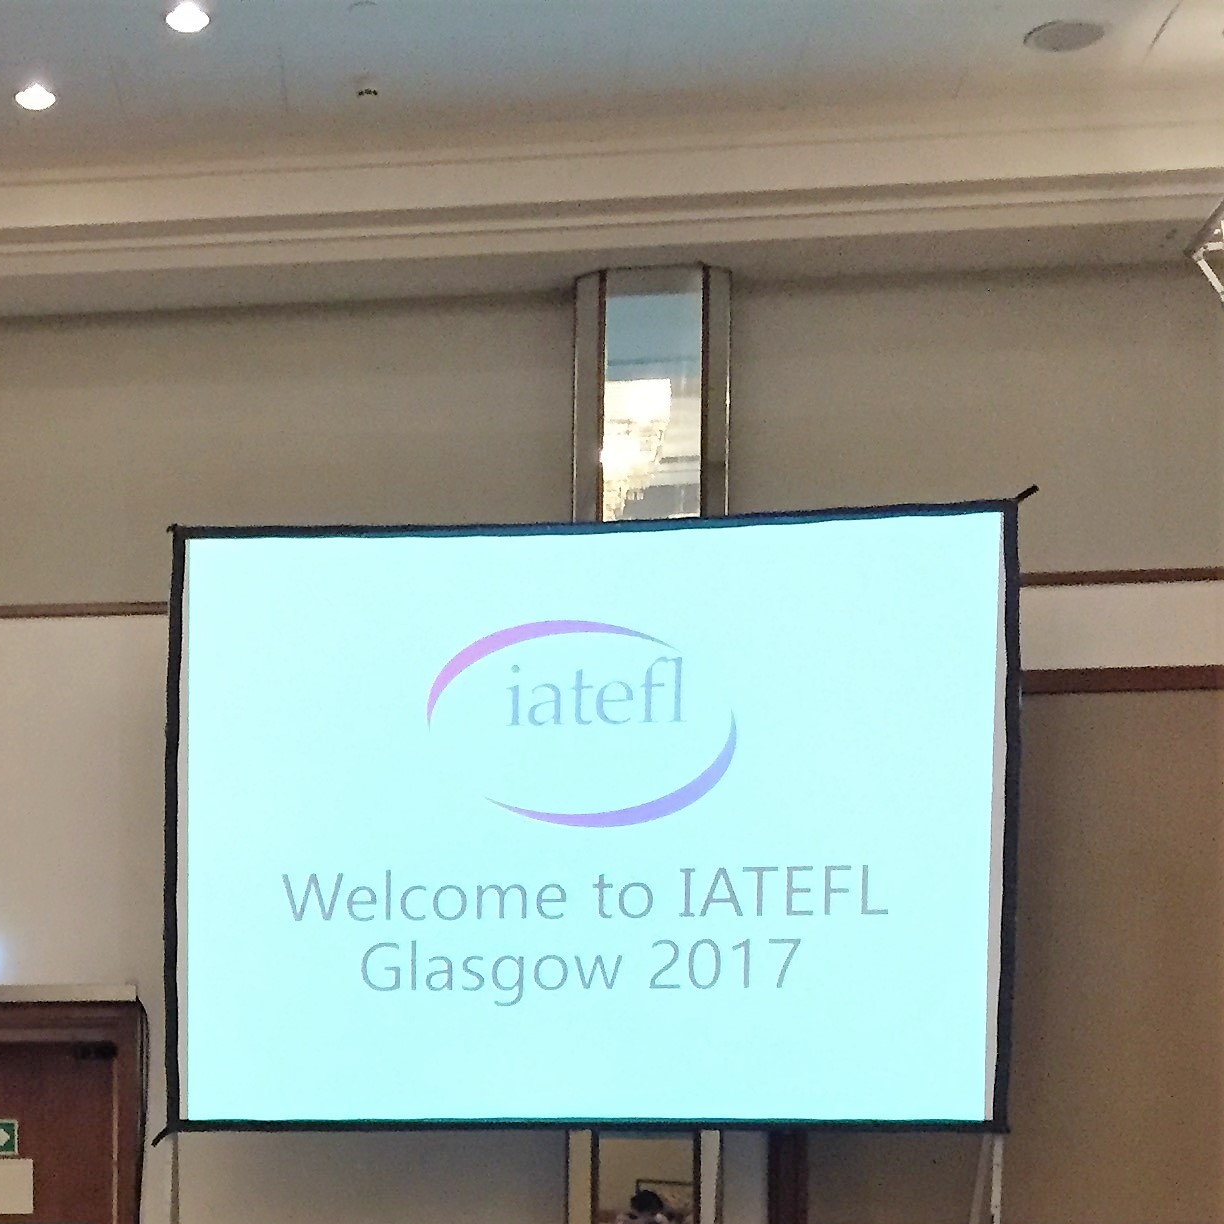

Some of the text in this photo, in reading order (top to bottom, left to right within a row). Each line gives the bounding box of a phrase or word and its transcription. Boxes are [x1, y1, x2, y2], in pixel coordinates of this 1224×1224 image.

[506, 656, 684, 727] iatefl
[281, 864, 889, 922] Welcome to IATEFL
[360, 937, 802, 1007] Glasgow 2017
